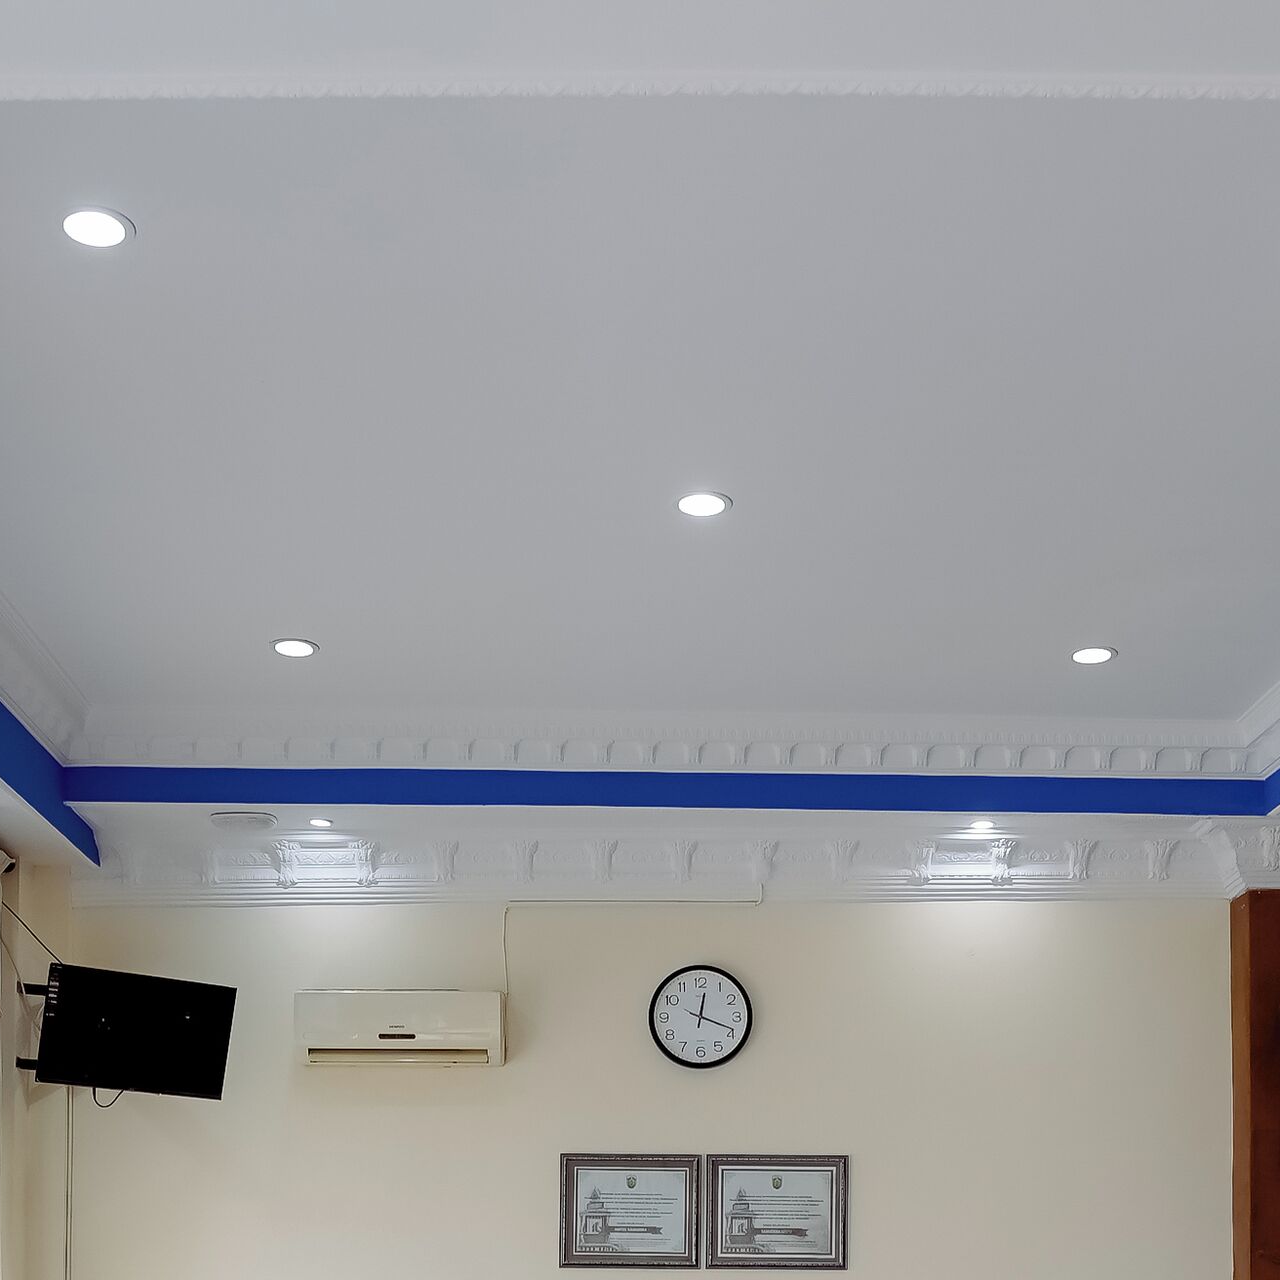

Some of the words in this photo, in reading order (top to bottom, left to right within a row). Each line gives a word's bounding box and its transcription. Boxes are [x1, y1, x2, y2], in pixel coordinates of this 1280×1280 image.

[678, 982, 686, 992] 11
[695, 977, 707, 988] 12
[665, 994, 679, 1006] 10
[726, 994, 736, 1005] 2
[659, 1012, 669, 1023] 9
[732, 1011, 742, 1023] 3
[665, 1029, 675, 1040] 8
[726, 1029, 735, 1039] 4
[679, 1041, 688, 1052] 7
[696, 1046, 706, 1058] 6
[713, 1041, 723, 1052] 5
